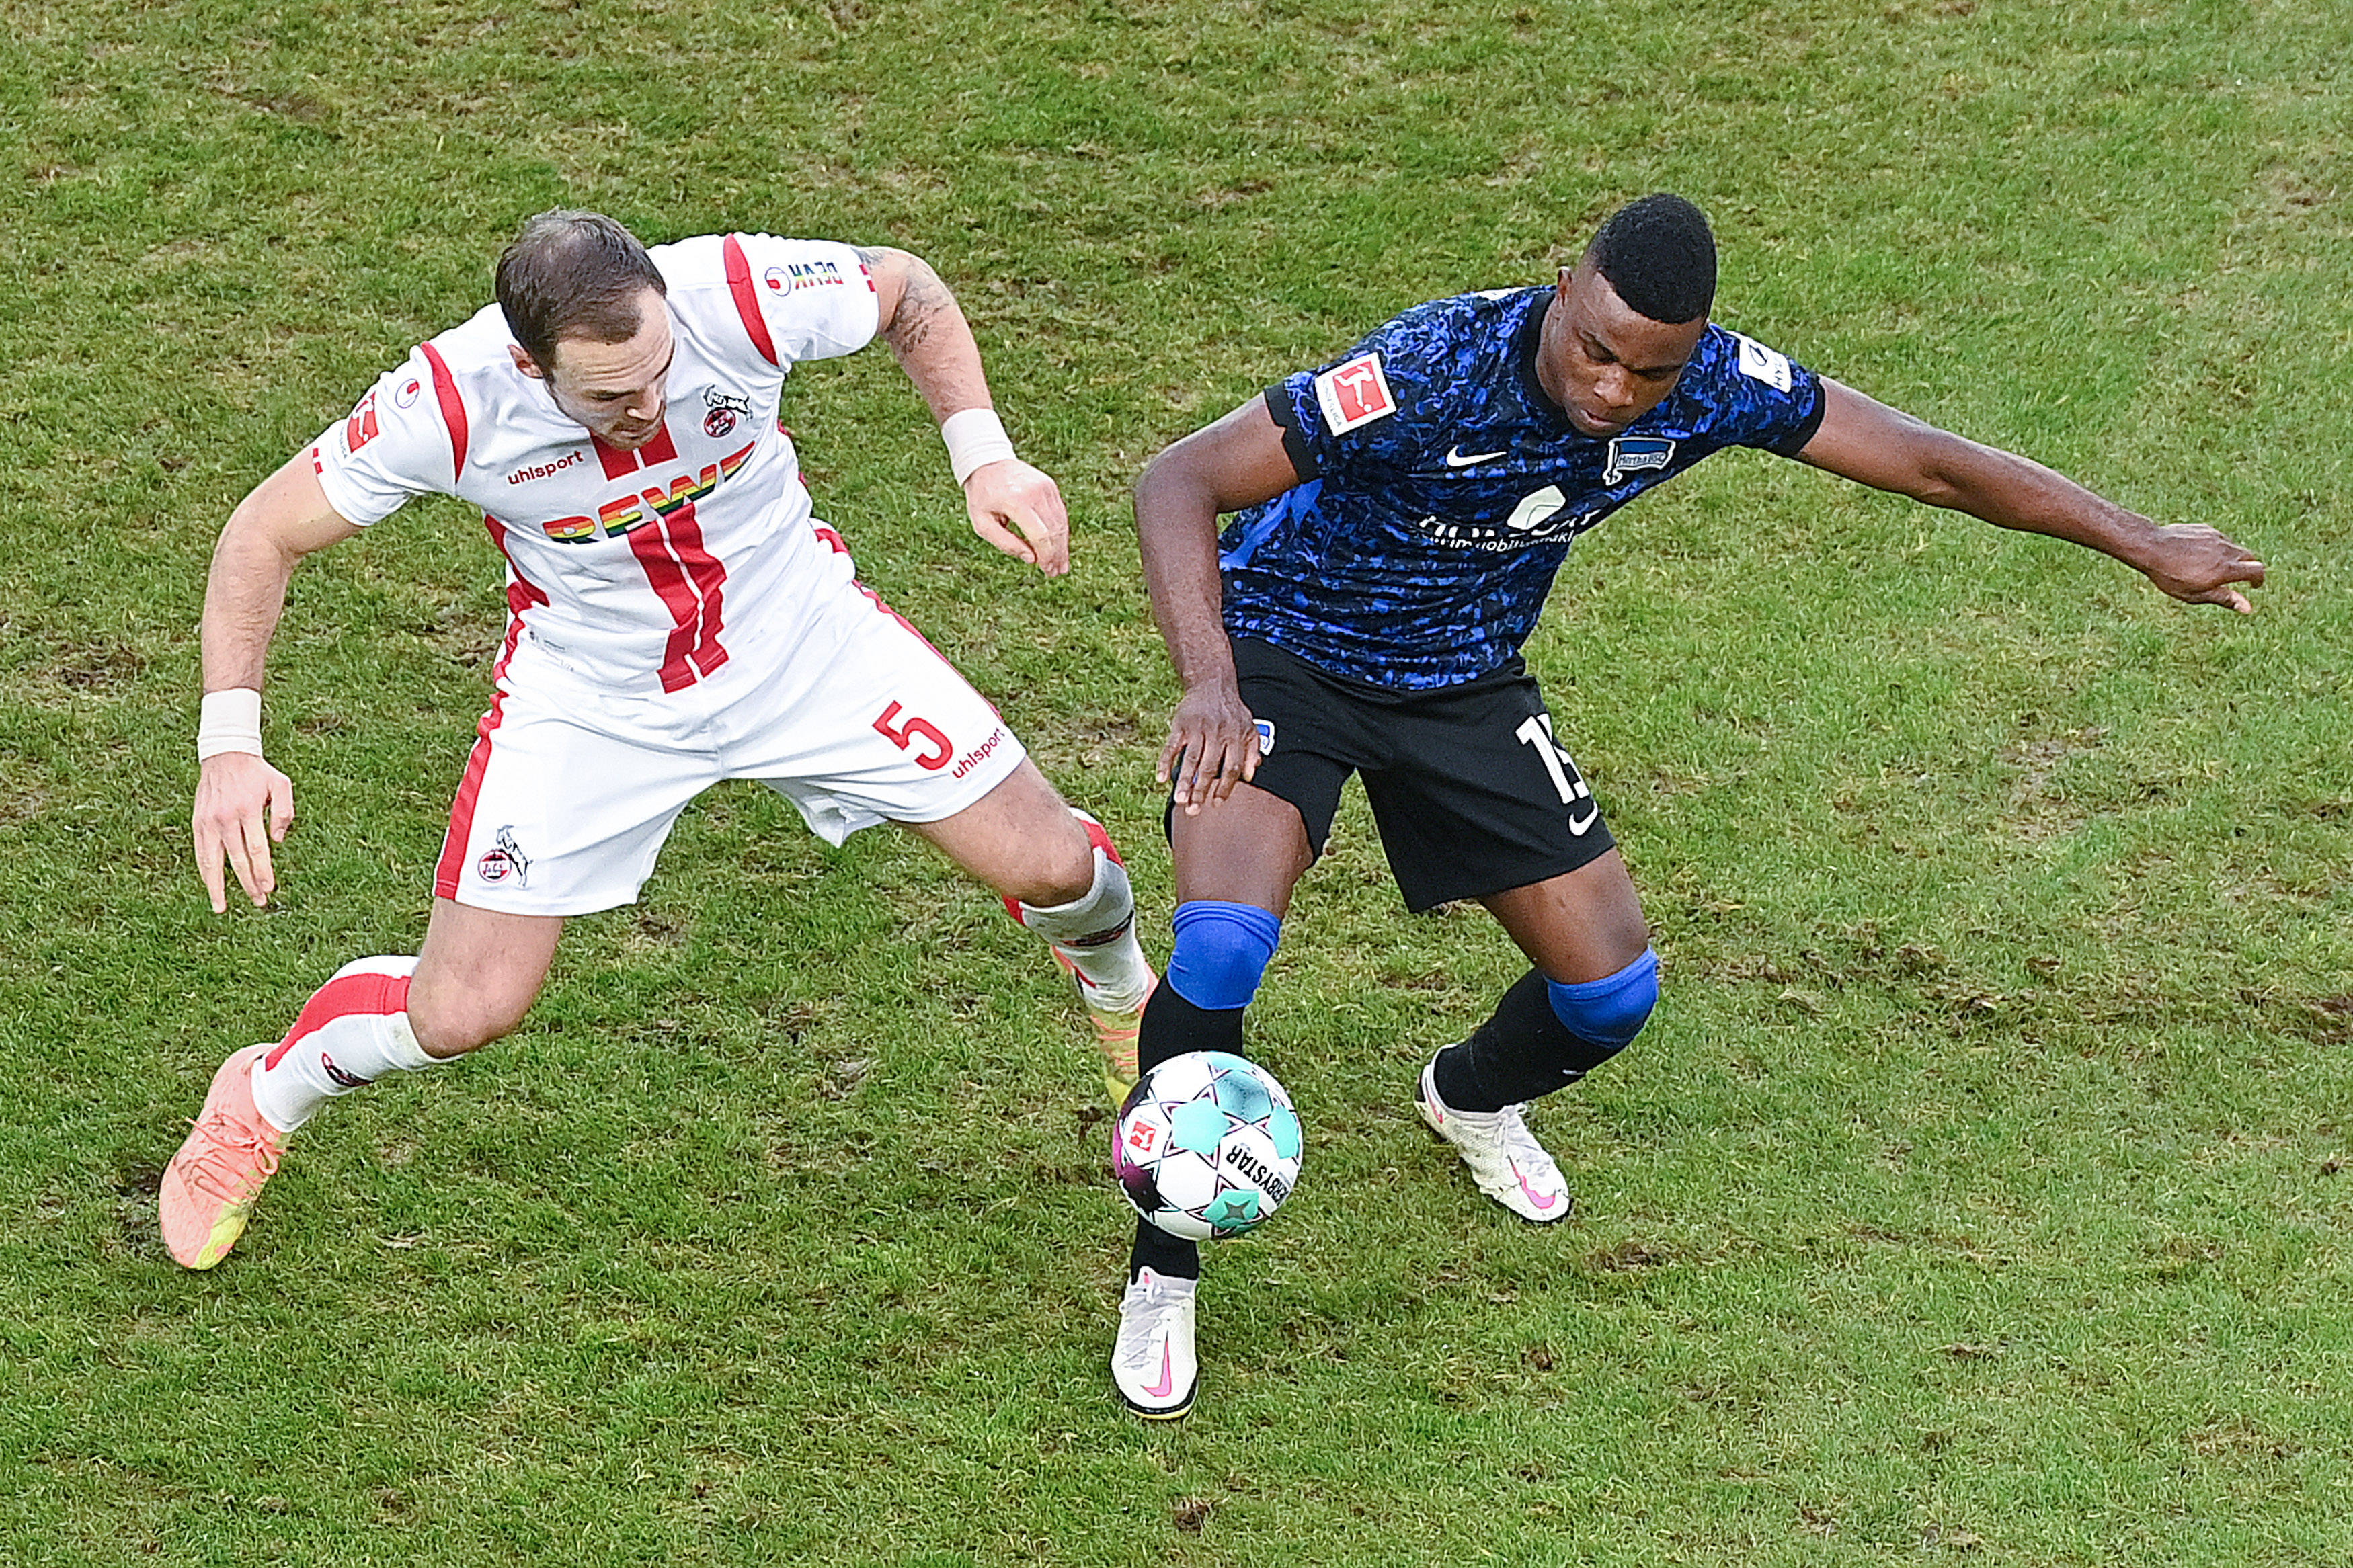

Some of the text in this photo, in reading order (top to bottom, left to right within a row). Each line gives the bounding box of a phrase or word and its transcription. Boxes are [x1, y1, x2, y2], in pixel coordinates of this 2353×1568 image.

[508, 450, 584, 485] uhlsport
[872, 700, 953, 771] 5
[952, 727, 1005, 779] uhlsport
[1226, 1145, 1289, 1206] ERBYSTAR
